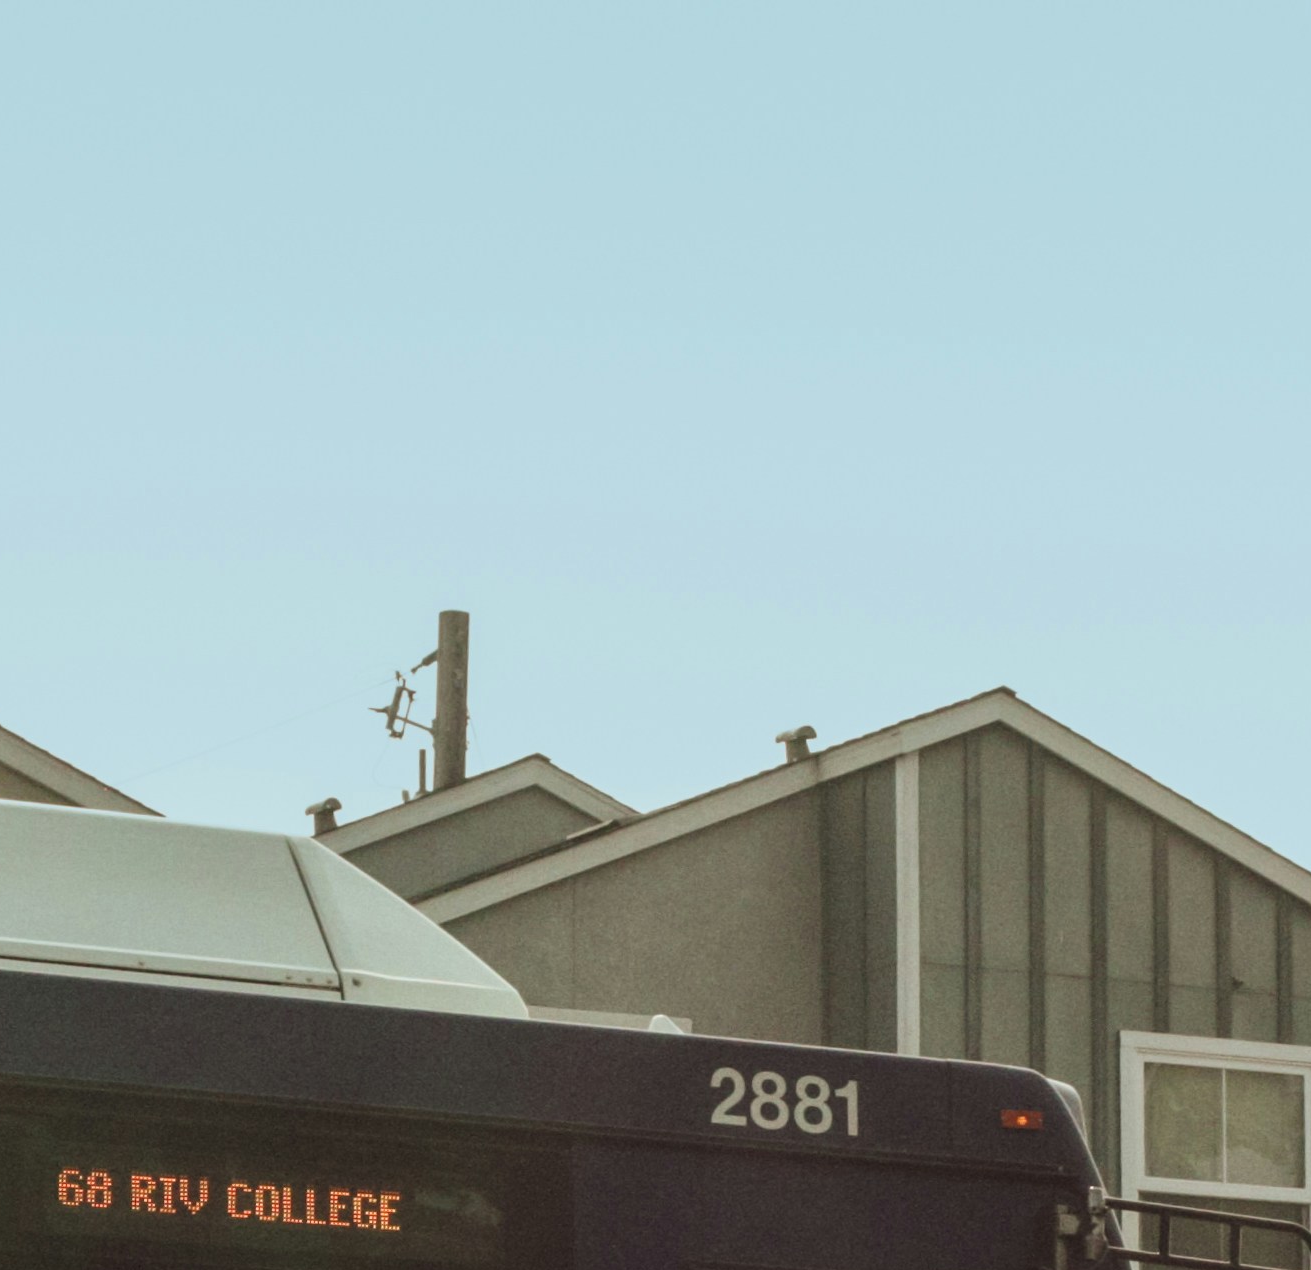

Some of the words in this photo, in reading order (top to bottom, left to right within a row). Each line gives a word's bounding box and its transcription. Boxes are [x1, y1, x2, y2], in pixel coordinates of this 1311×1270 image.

[709, 1066, 859, 1137] 2881
[57, 1168, 113, 1209] 68
[130, 1173, 209, 1216] RIV
[227, 1181, 401, 1232] COLLEGE
